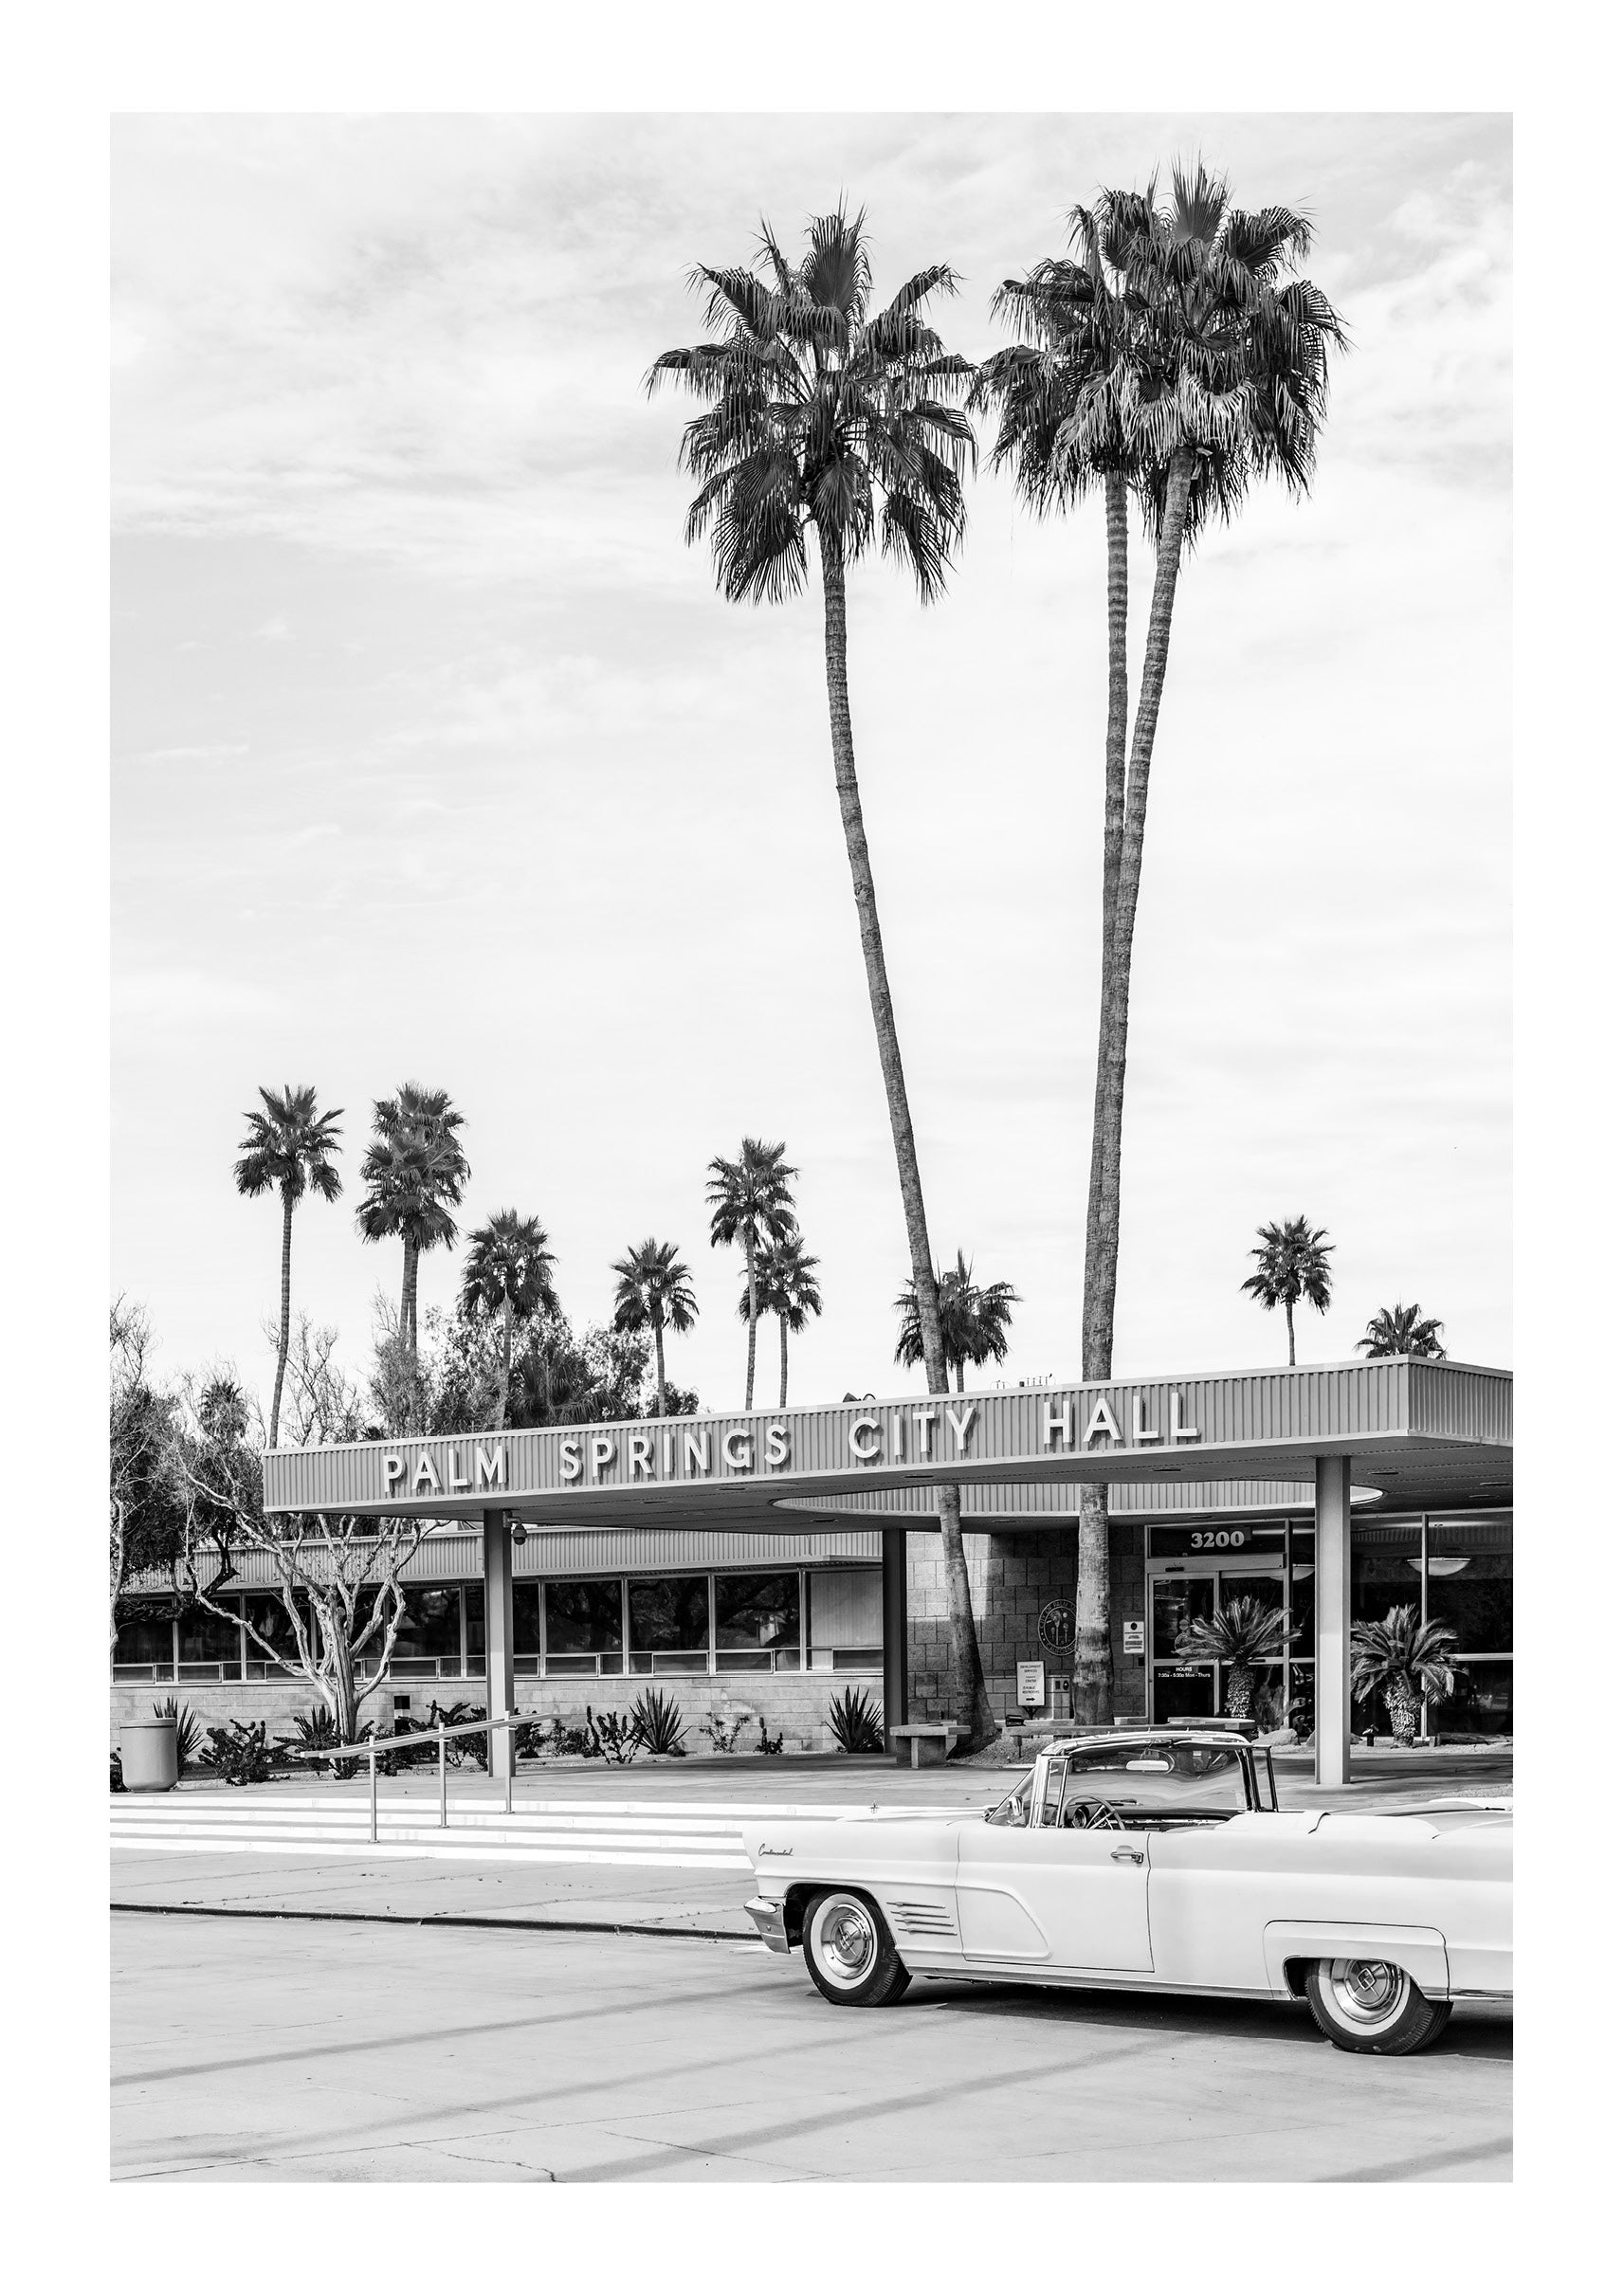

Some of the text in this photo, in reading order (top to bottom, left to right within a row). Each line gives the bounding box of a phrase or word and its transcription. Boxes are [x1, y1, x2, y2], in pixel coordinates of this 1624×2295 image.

[382, 1391, 1201, 1493] PALM SPRINGS CITY HALL
[1191, 1530, 1245, 1548] 3200
